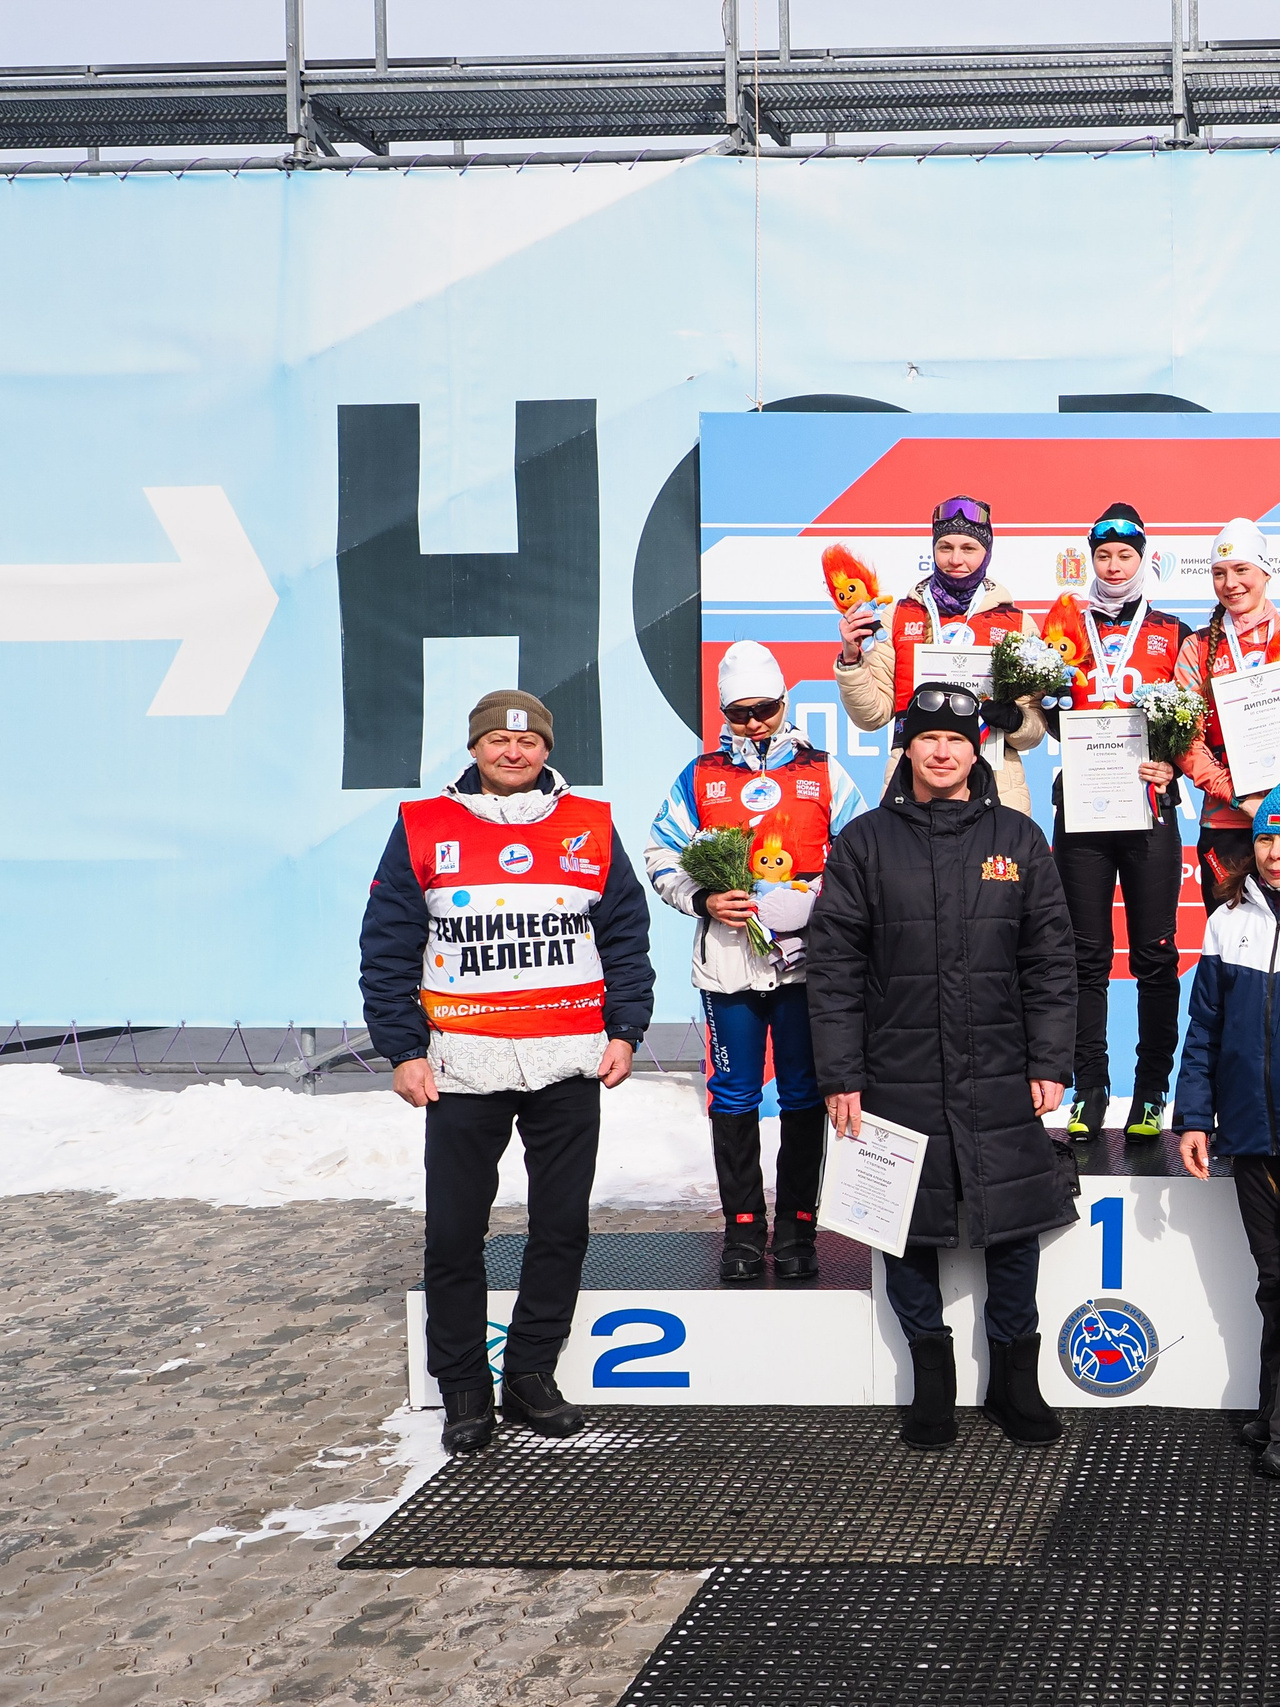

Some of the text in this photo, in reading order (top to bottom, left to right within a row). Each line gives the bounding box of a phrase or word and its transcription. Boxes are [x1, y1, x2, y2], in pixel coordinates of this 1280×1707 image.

[1087, 667, 1142, 702] 10
[1243, 696, 1280, 712] ДИПЛОМ
[1086, 742, 1124, 751] ДИПЛОМ
[459, 938, 576, 977] ДЕЛЕГАТ
[705, 990, 724, 1072] АНКТ-ПЕТЕРБУРГ
[858, 1148, 896, 1168] ДИПЛОМ
[1091, 1197, 1124, 1289] 1
[591, 1308, 690, 1388] 2
[1060, 1304, 1157, 1355] АКАДЕМИЯ БИАТЛОНА
